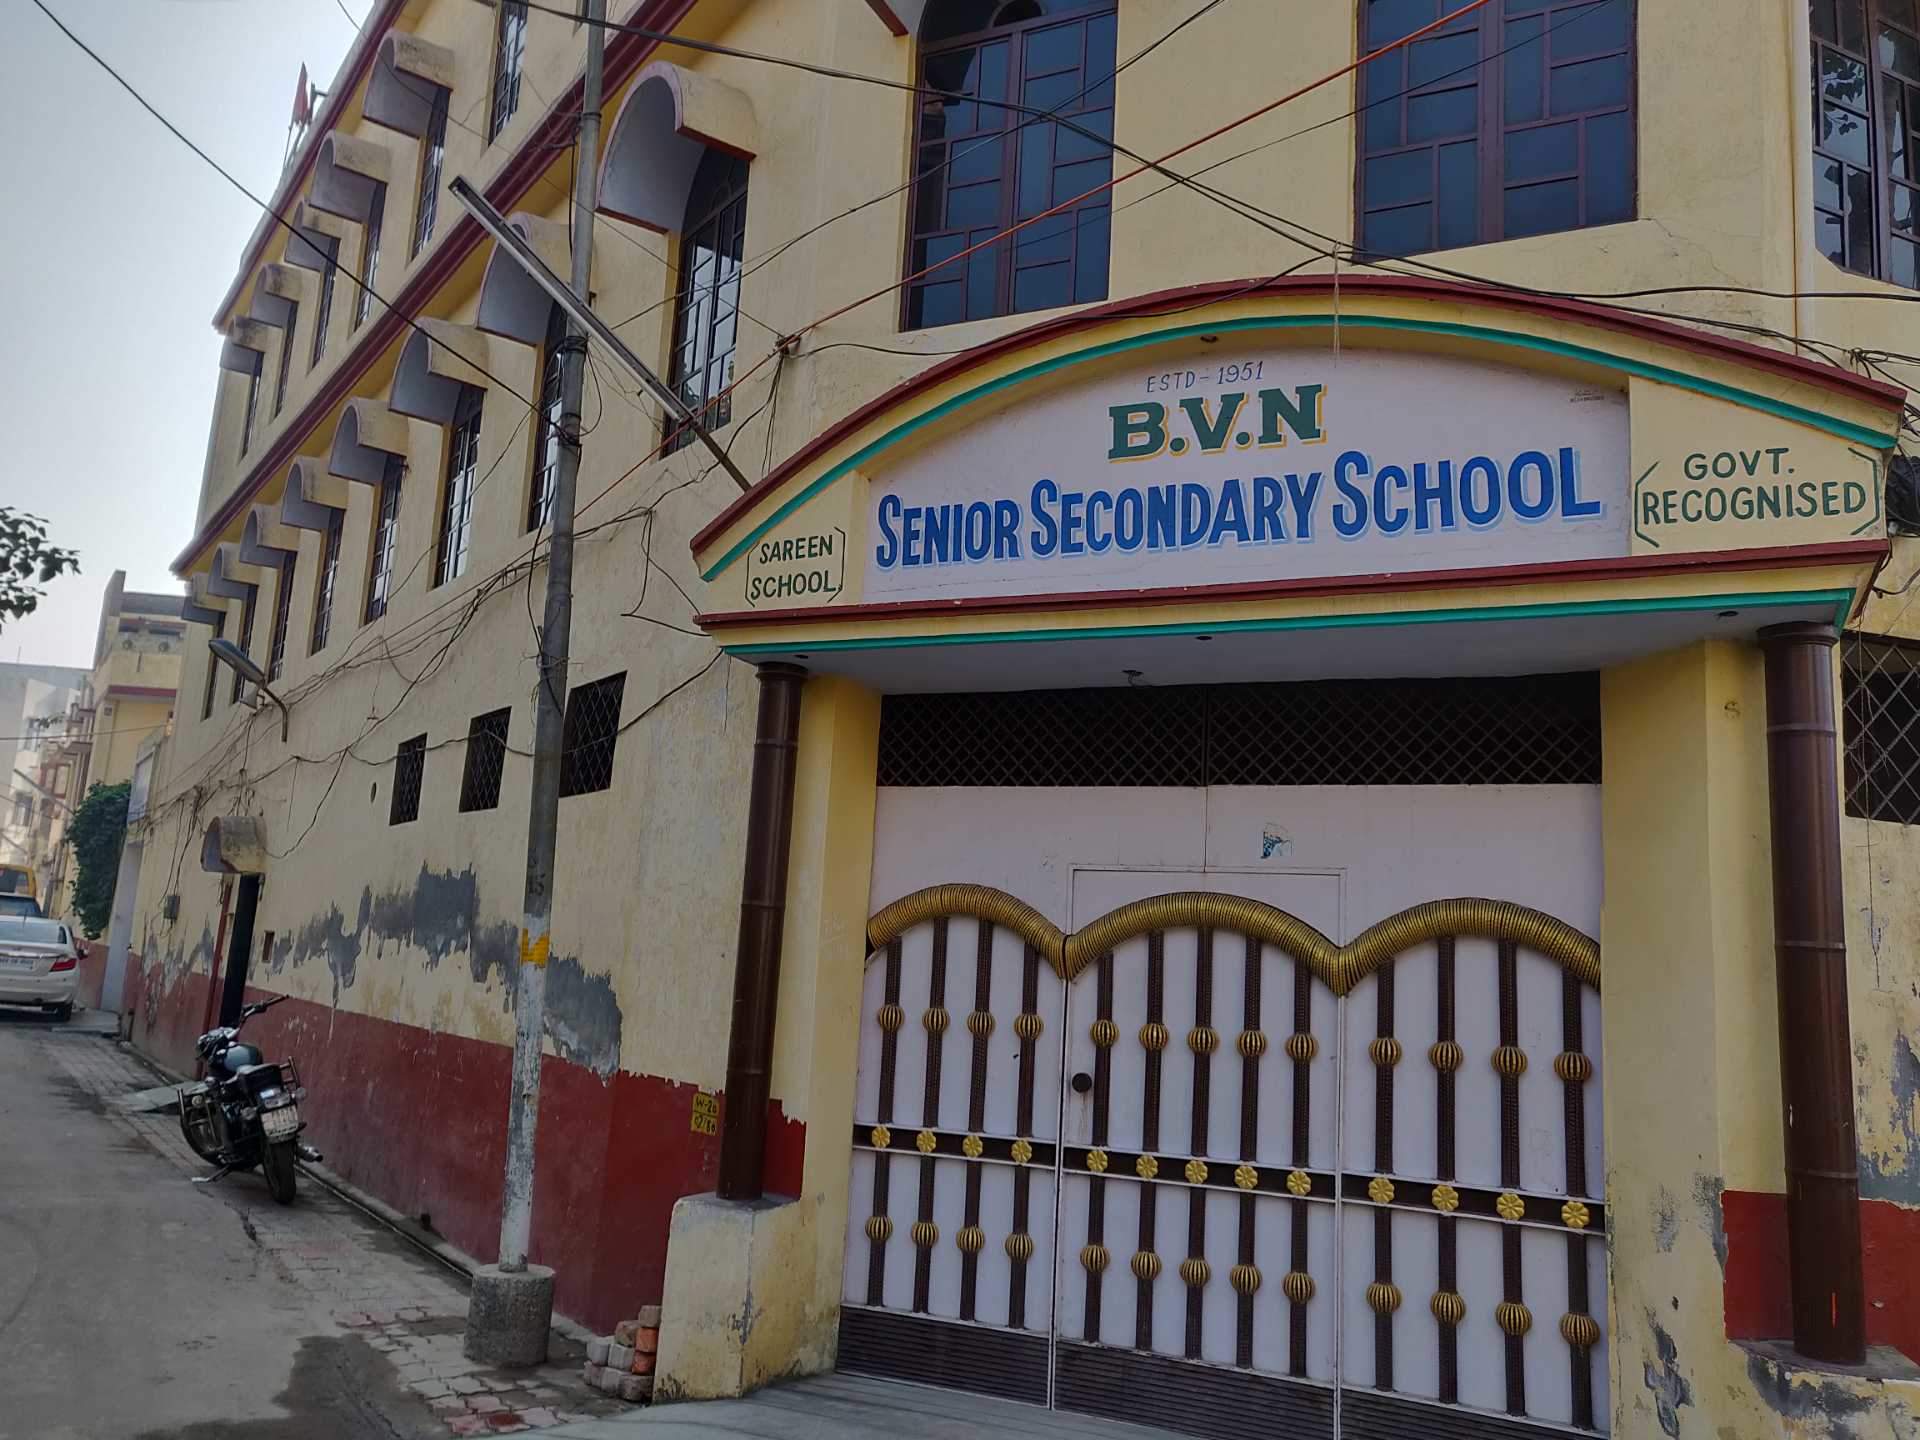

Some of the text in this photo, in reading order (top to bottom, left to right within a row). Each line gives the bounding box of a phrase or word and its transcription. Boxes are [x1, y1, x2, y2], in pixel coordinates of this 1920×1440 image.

[1216, 360, 1264, 385] 1951
[1107, 383, 1328, 463] B.V.N
[1683, 447, 1795, 480] GOVT.
[875, 446, 1604, 570] SENIOR SECONDARY SCHOOL
[1642, 481, 1867, 525] RECOGNISED
[759, 534, 833, 564] SAREEN
[750, 570, 837, 600] SCHOOL
